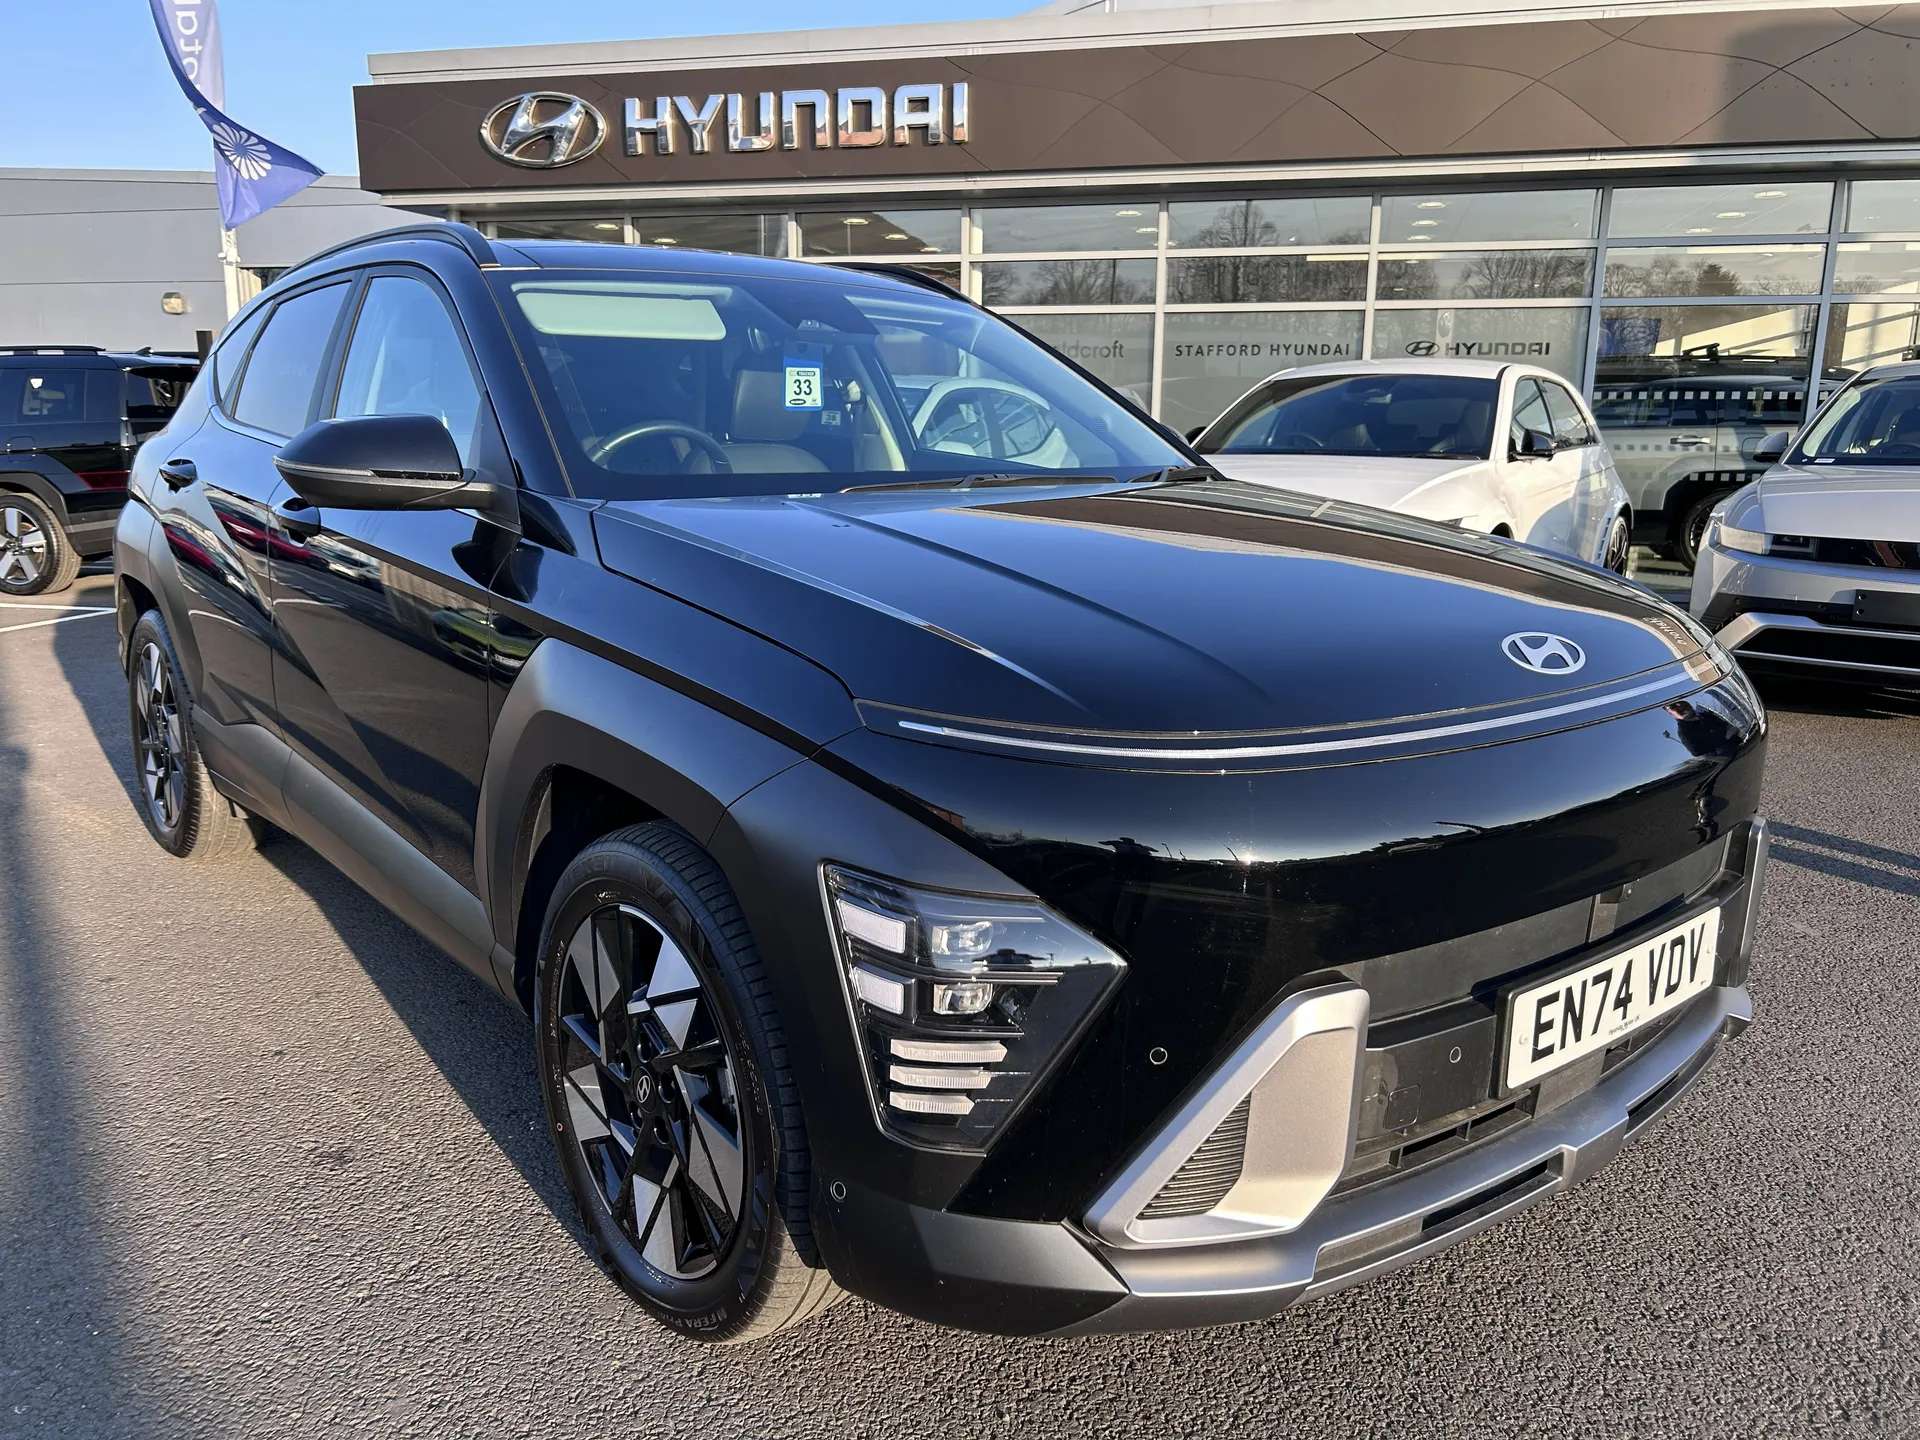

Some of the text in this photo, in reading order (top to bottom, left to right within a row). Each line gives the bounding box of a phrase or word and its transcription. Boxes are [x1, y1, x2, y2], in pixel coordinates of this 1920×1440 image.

[624, 82, 969, 156] HYUNDAI
[1175, 343, 1350, 357] STAFFORD HYUNDAI
[1445, 342, 1551, 356] HYUNDAI
[793, 379, 812, 396] 33
[1531, 922, 1706, 1064] EN74 VDV
